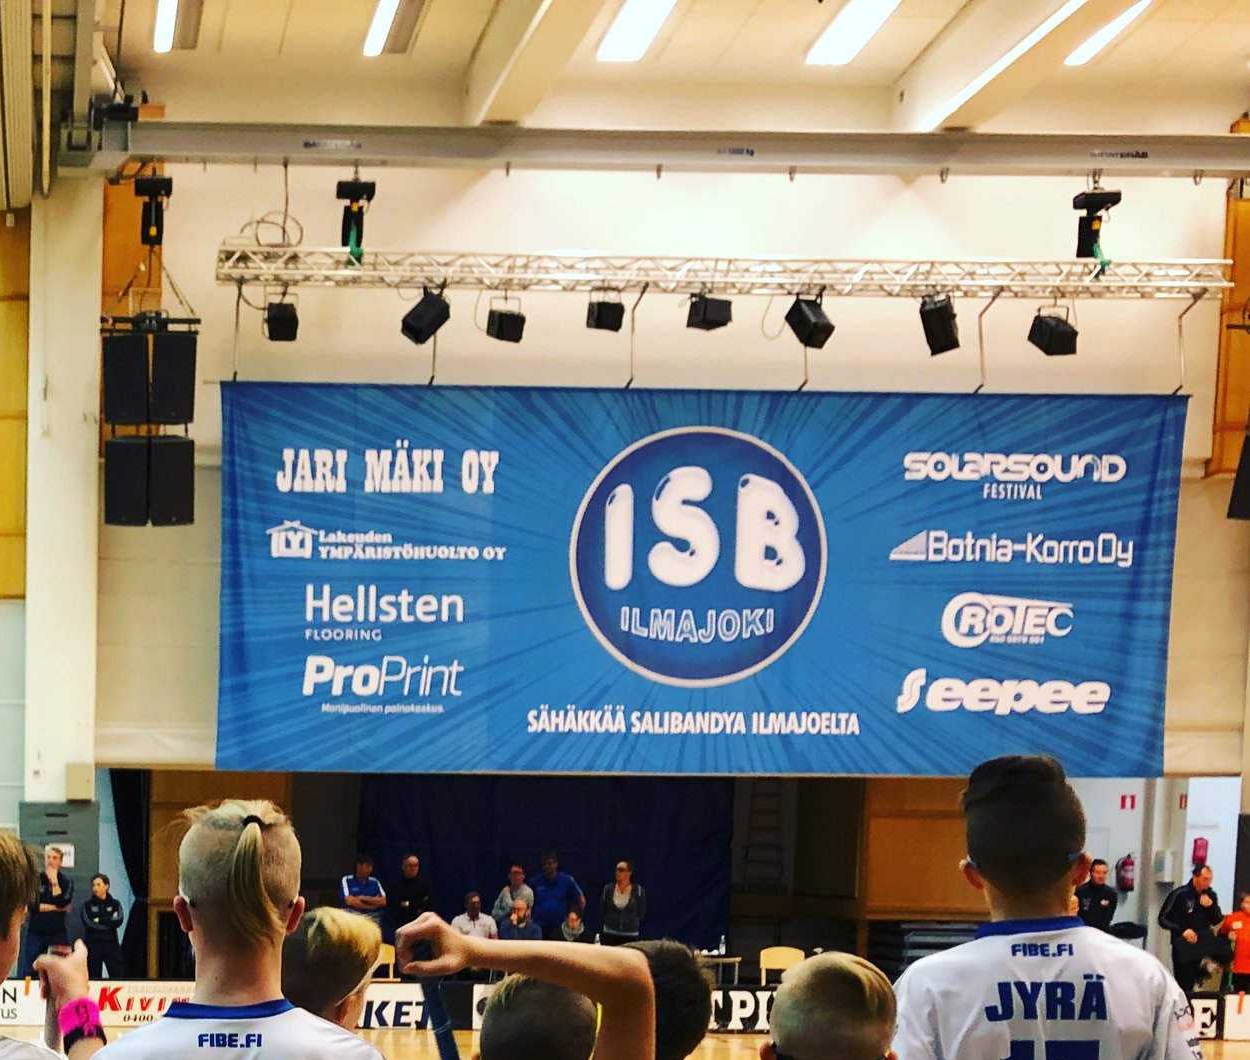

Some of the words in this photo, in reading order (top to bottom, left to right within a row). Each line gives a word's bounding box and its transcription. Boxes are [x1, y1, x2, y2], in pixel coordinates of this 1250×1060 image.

[276, 448, 348, 493] JARI
[364, 439, 445, 493] MÄKI
[462, 449, 499, 494] OY
[983, 483, 1043, 500] FESTIVAL
[319, 530, 392, 544] Lakeuden
[604, 465, 806, 592] ISB
[319, 543, 479, 560] YMPÄRISTÖHUOLTO
[482, 546, 507, 561] OY
[928, 530, 1094, 564] Botnia-Korro
[1097, 533, 1133, 568] Oy
[305, 583, 464, 623] Hellsten
[304, 628, 383, 641] FLOORING
[620, 606, 775, 644] ILMAJOKI
[302, 654, 465, 697] ProPrint
[896, 668, 1111, 716] Seepee
[527, 704, 626, 734] SÄHÄKKÄÄ
[631, 710, 746, 735] SALIBANDYA
[752, 712, 860, 735] ILMAJOELTA
[985, 974, 1108, 1022] JYRÄ
[198, 1033, 263, 1048] FIBE.FI
